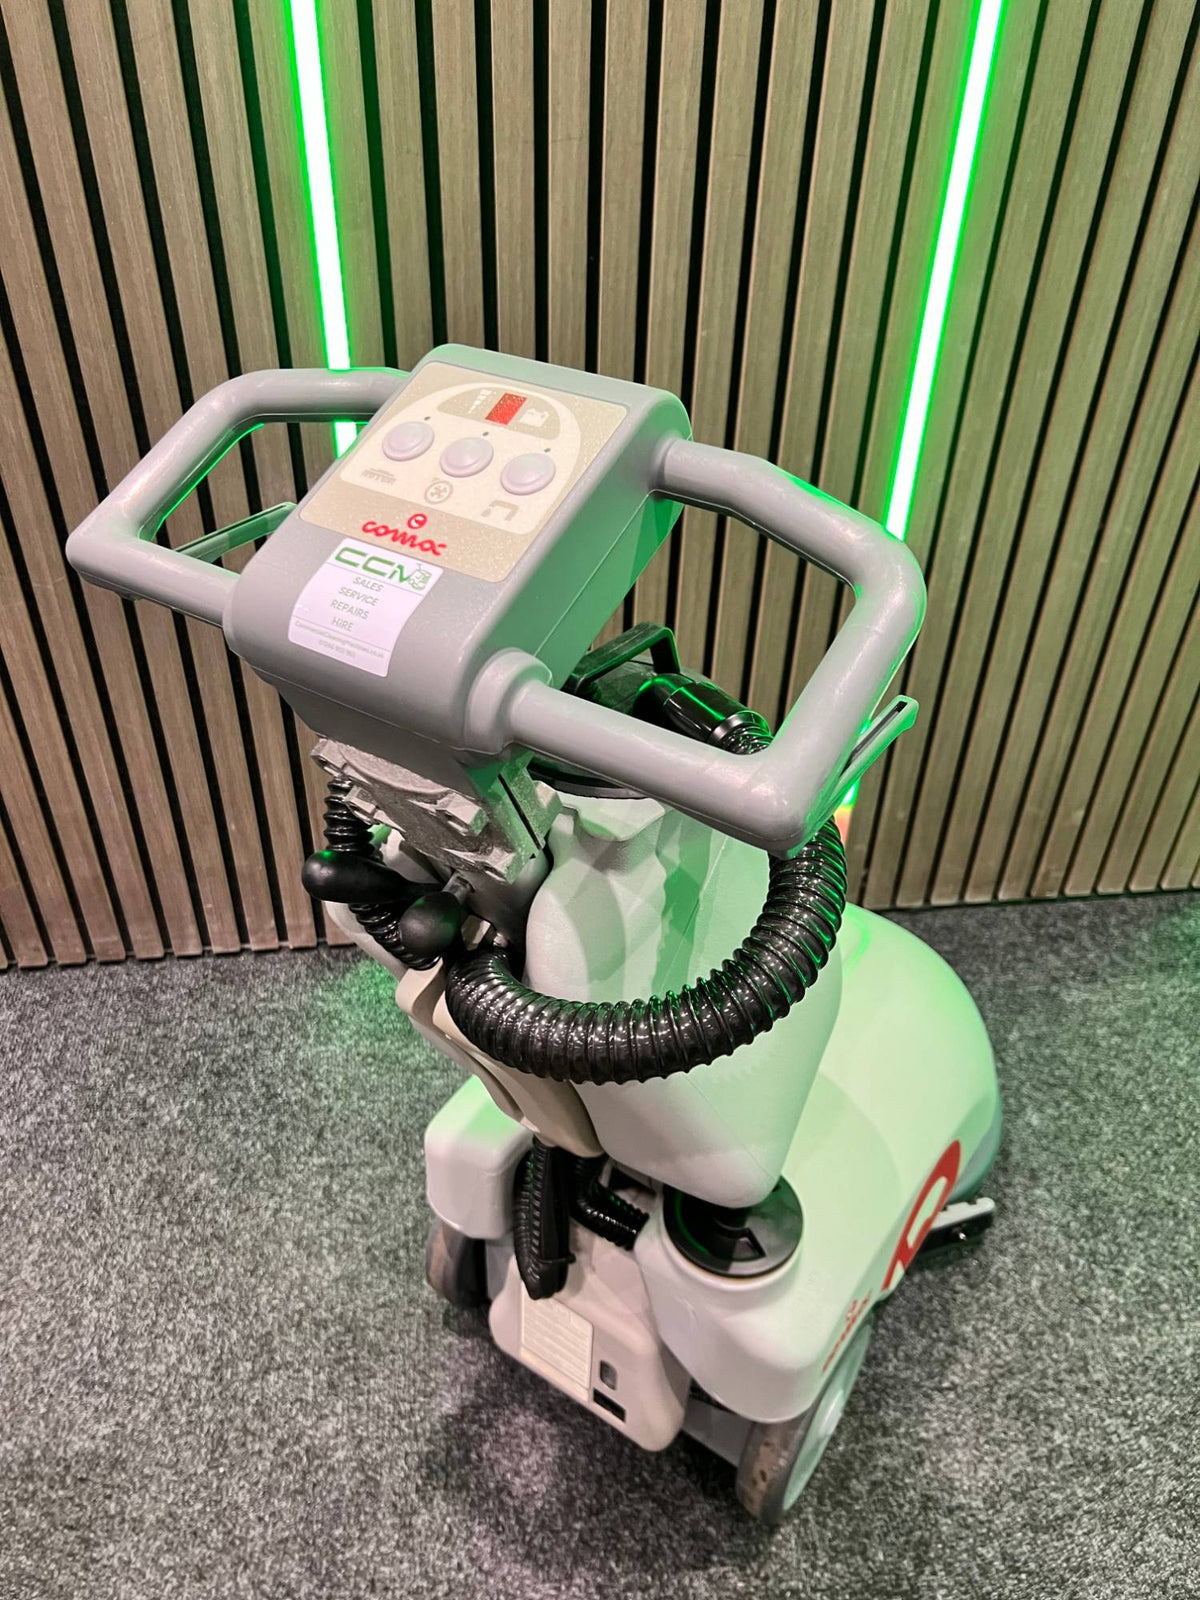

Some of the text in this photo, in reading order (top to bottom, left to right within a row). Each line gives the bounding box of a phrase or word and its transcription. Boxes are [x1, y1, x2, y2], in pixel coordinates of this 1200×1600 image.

[353, 576, 384, 592] SALES
[338, 587, 379, 606] SERVICE
[330, 599, 370, 620] REPAIRS
[331, 617, 354, 632] HIRE
